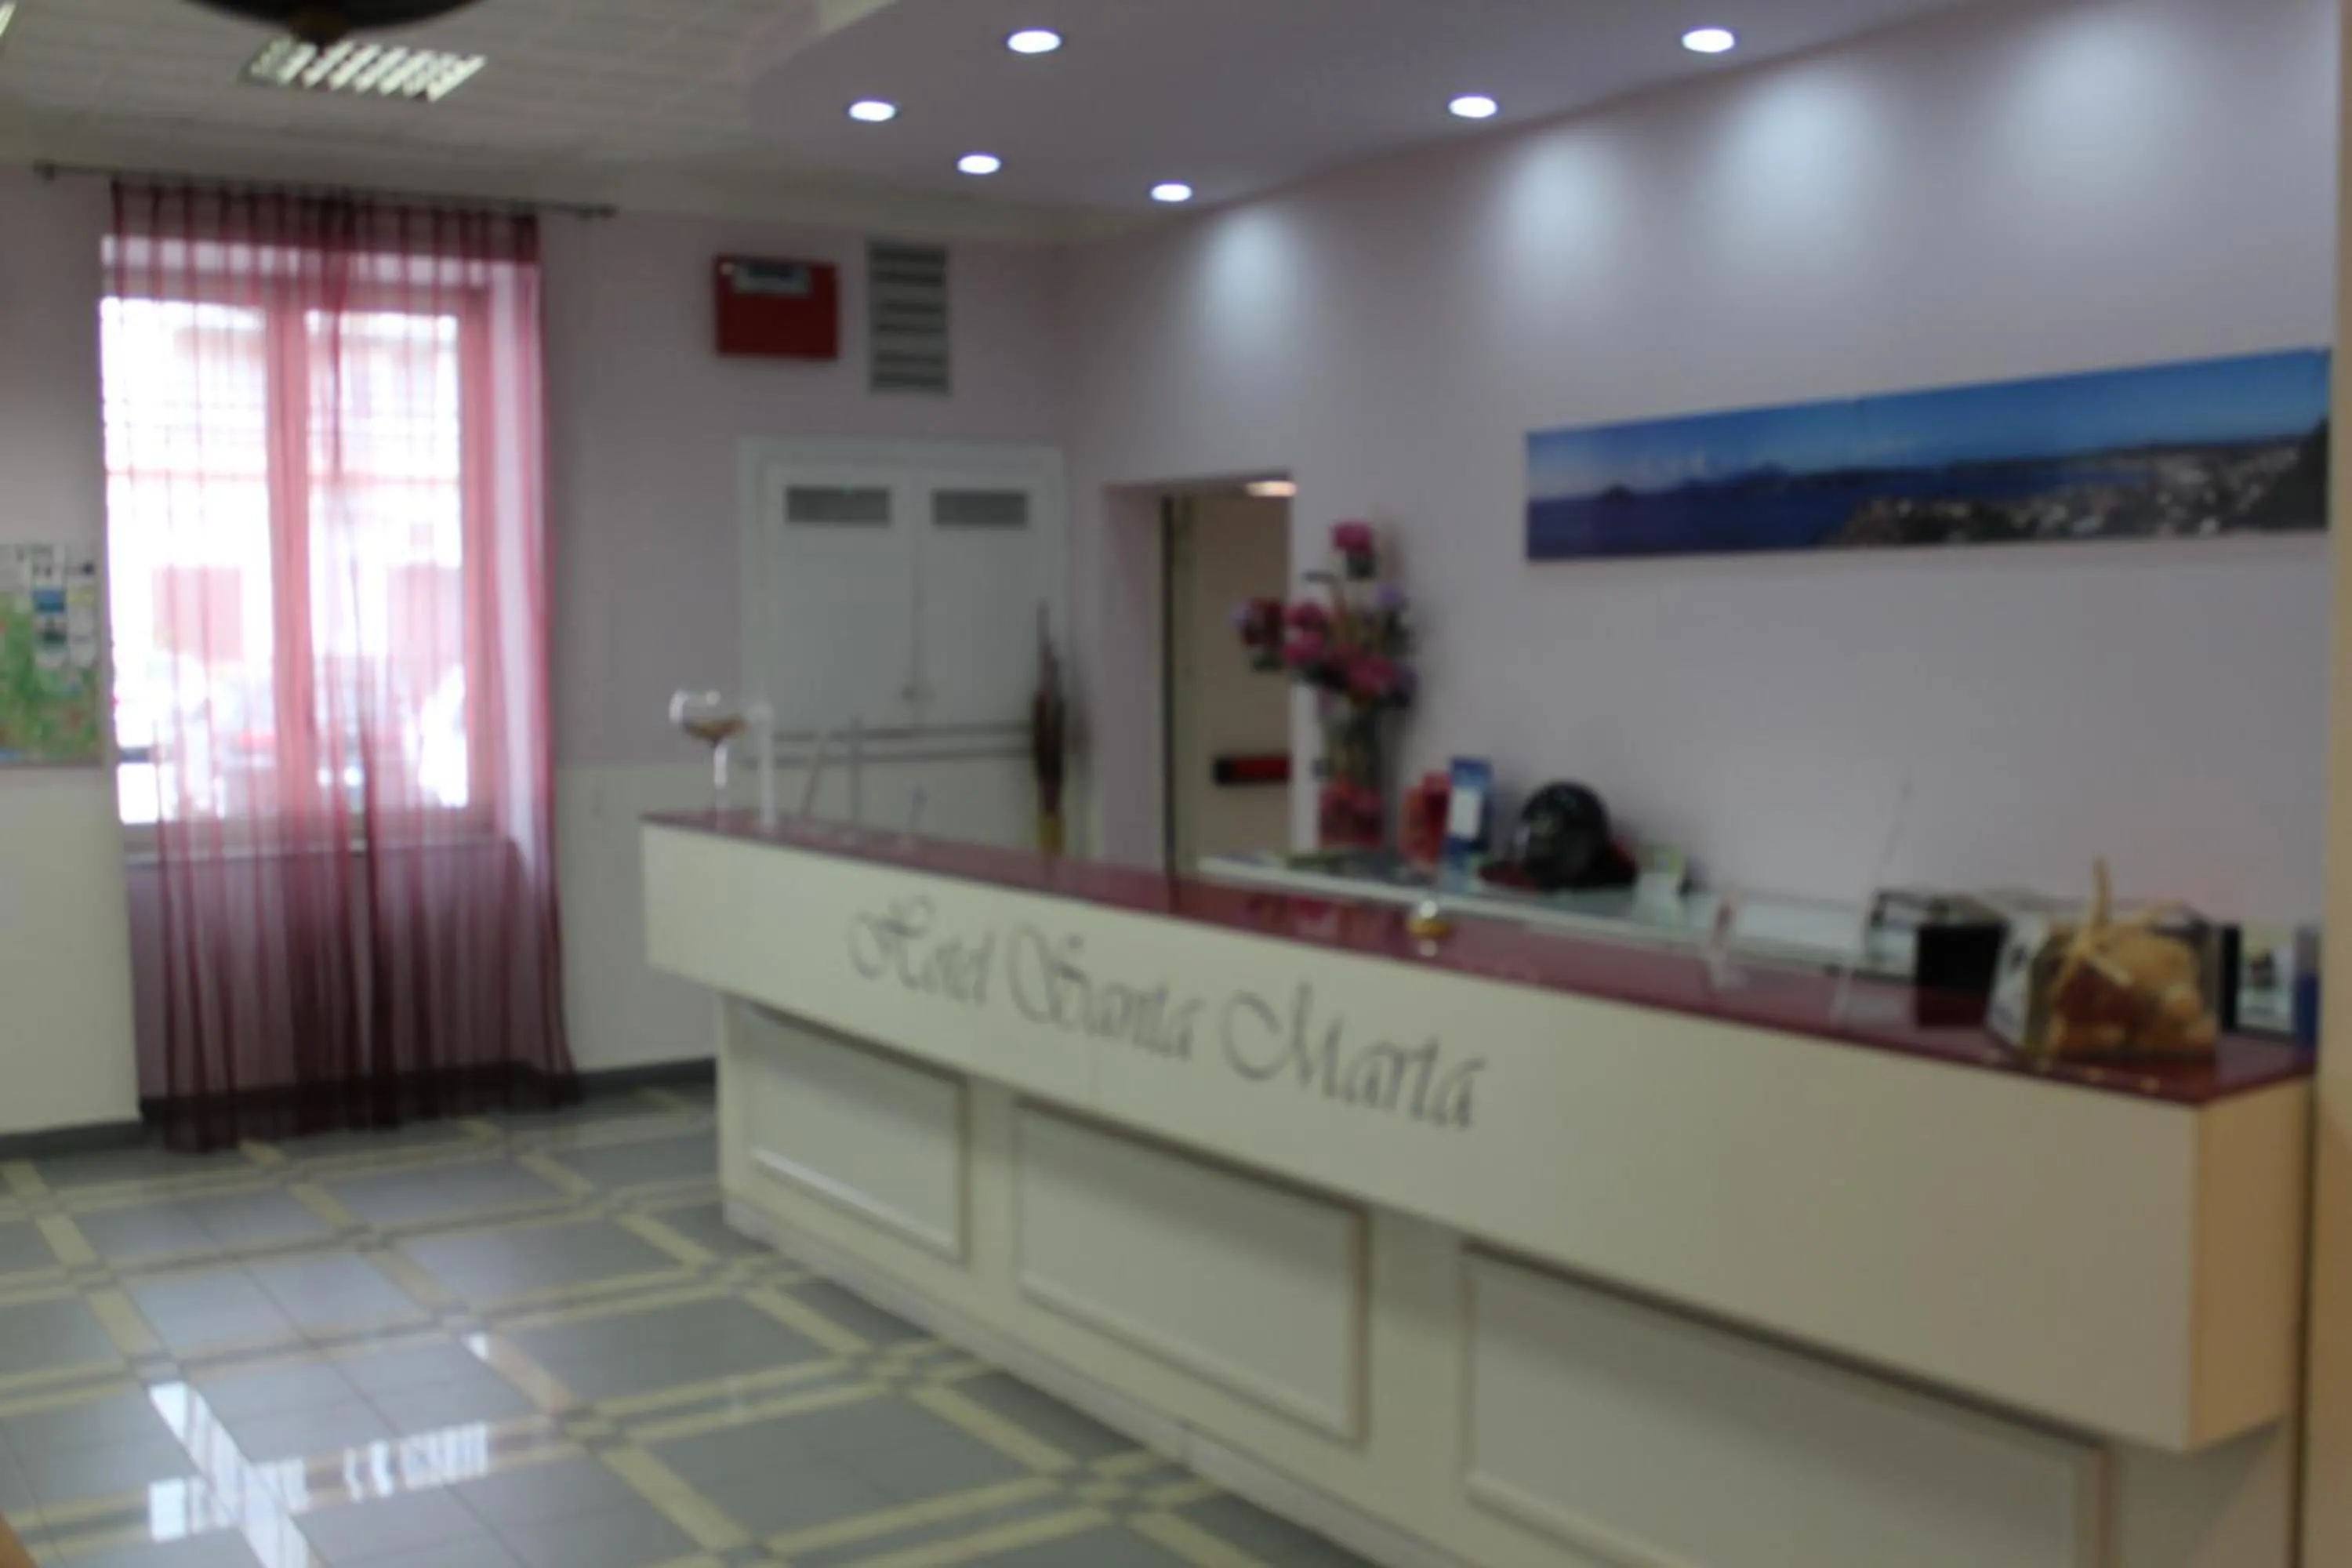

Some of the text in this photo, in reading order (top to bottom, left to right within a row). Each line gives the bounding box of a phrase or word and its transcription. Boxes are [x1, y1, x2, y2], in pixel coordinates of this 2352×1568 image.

[847, 895, 1489, 1128] Hotel Santa Marta
